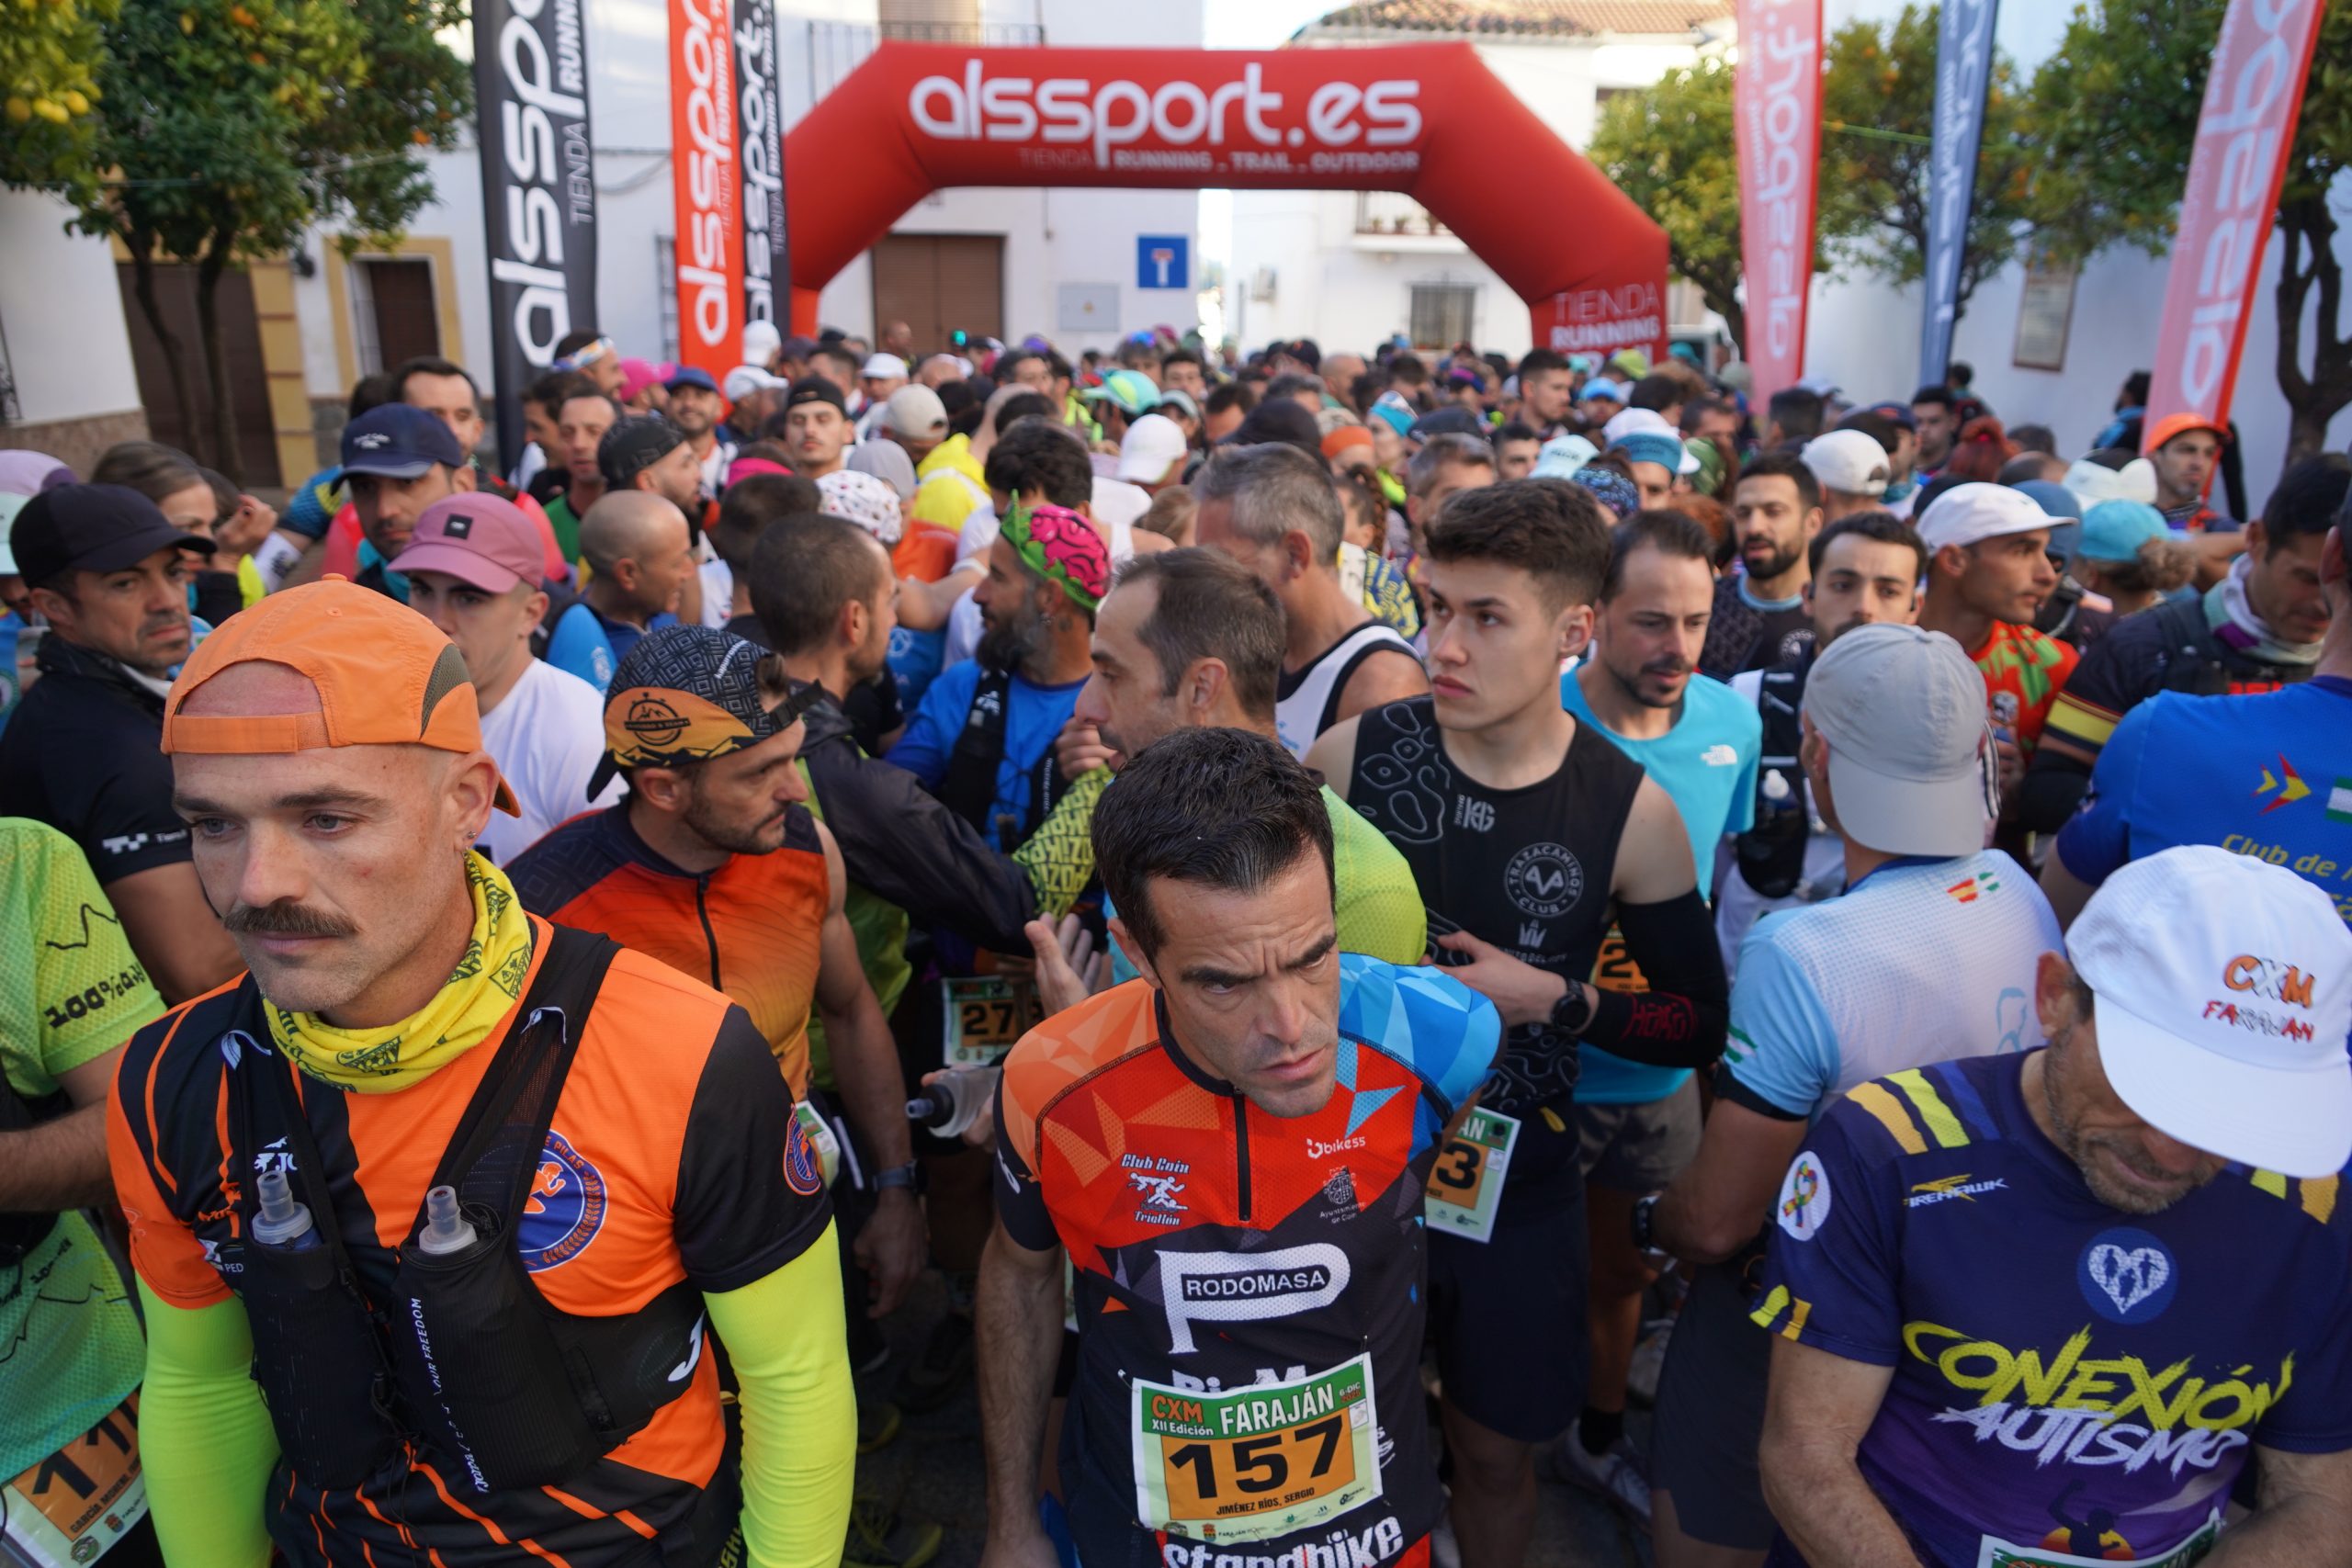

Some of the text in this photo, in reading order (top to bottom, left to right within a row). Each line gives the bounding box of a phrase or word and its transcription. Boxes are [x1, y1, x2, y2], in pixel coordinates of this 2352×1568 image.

[909, 58, 1423, 171] alssport.es
[561, 122, 594, 226] TIENDA
[1018, 147, 1420, 173] TIENDA RUNNING TRAIL OUTDOOR
[1554, 283, 1660, 321] TIENDA
[1551, 315, 1661, 352] RUNNING
[2222, 834, 2289, 865] Club
[2294, 854, 2337, 877] de
[1518, 897, 1560, 914] CLUB
[2223, 954, 2315, 1009] CXM
[554, 1140, 585, 1169] PILAS
[1121, 1154, 1154, 1169] Club
[1186, 1269, 1327, 1297] RODOMASA
[411, 1297, 434, 1359] FREEDOM
[1903, 1323, 2296, 1435] CONEXIÓN
[1151, 1394, 1204, 1424] CXM
[1219, 1382, 1334, 1435] FARAJÁN
[1152, 1419, 1167, 1431] XII
[1169, 1421, 1214, 1435] Edición
[1169, 1415, 1343, 1499] 157
[1929, 1402, 2248, 1481] AUTISMO
[69, 1502, 103, 1533] GARCÍA
[1216, 1486, 1315, 1516] JIMÉNEZ RÍOS, SERGIO
